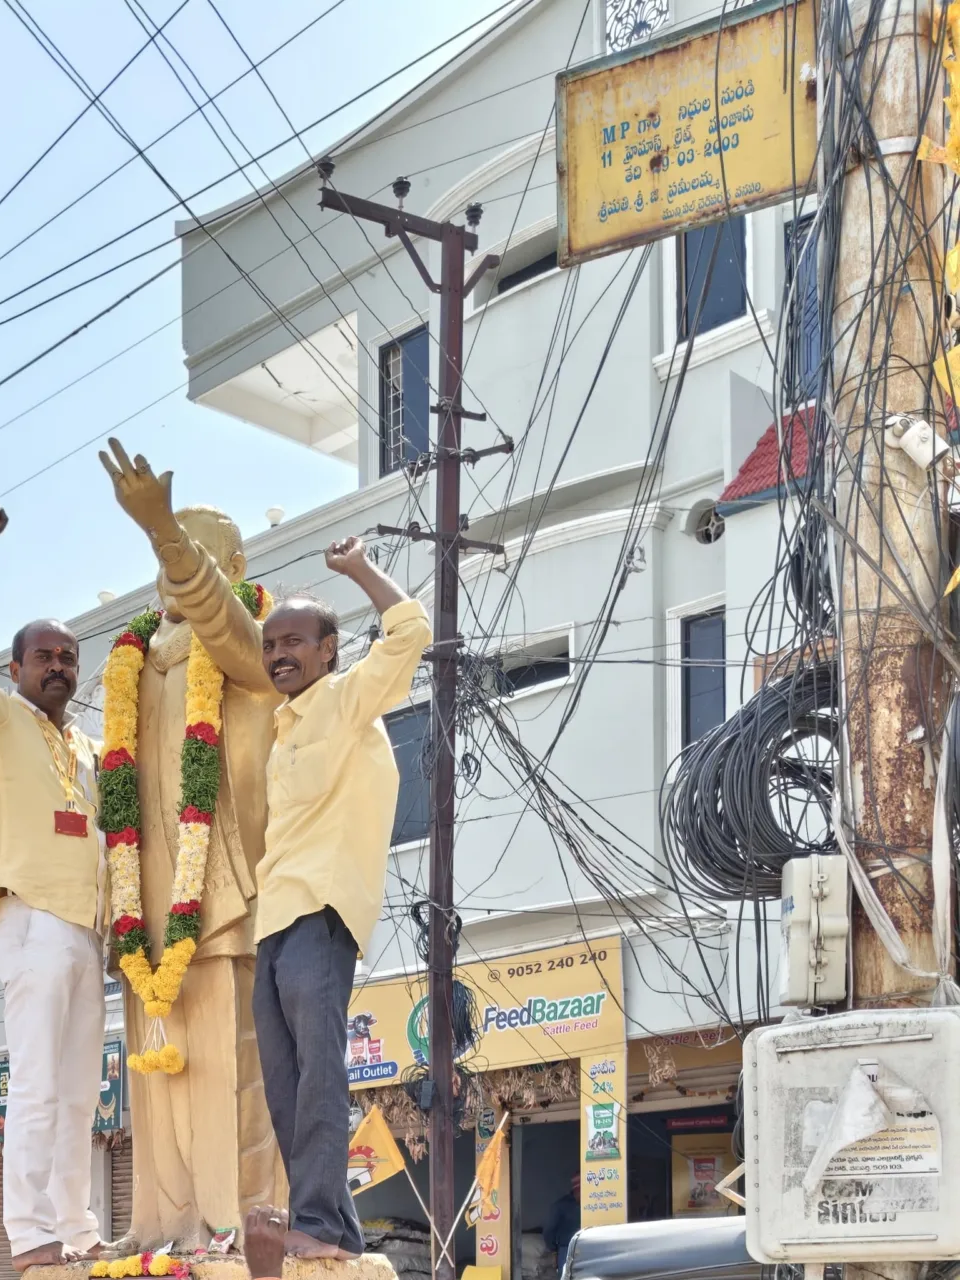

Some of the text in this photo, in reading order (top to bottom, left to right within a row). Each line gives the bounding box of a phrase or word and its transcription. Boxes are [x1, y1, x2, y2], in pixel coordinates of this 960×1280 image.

[507, 950, 607, 979] 9052 240 240
[483, 993, 606, 1033] FeedBazaar
[543, 1019, 598, 1036] Cattle Feed
[362, 1064, 393, 1078] Outlet
